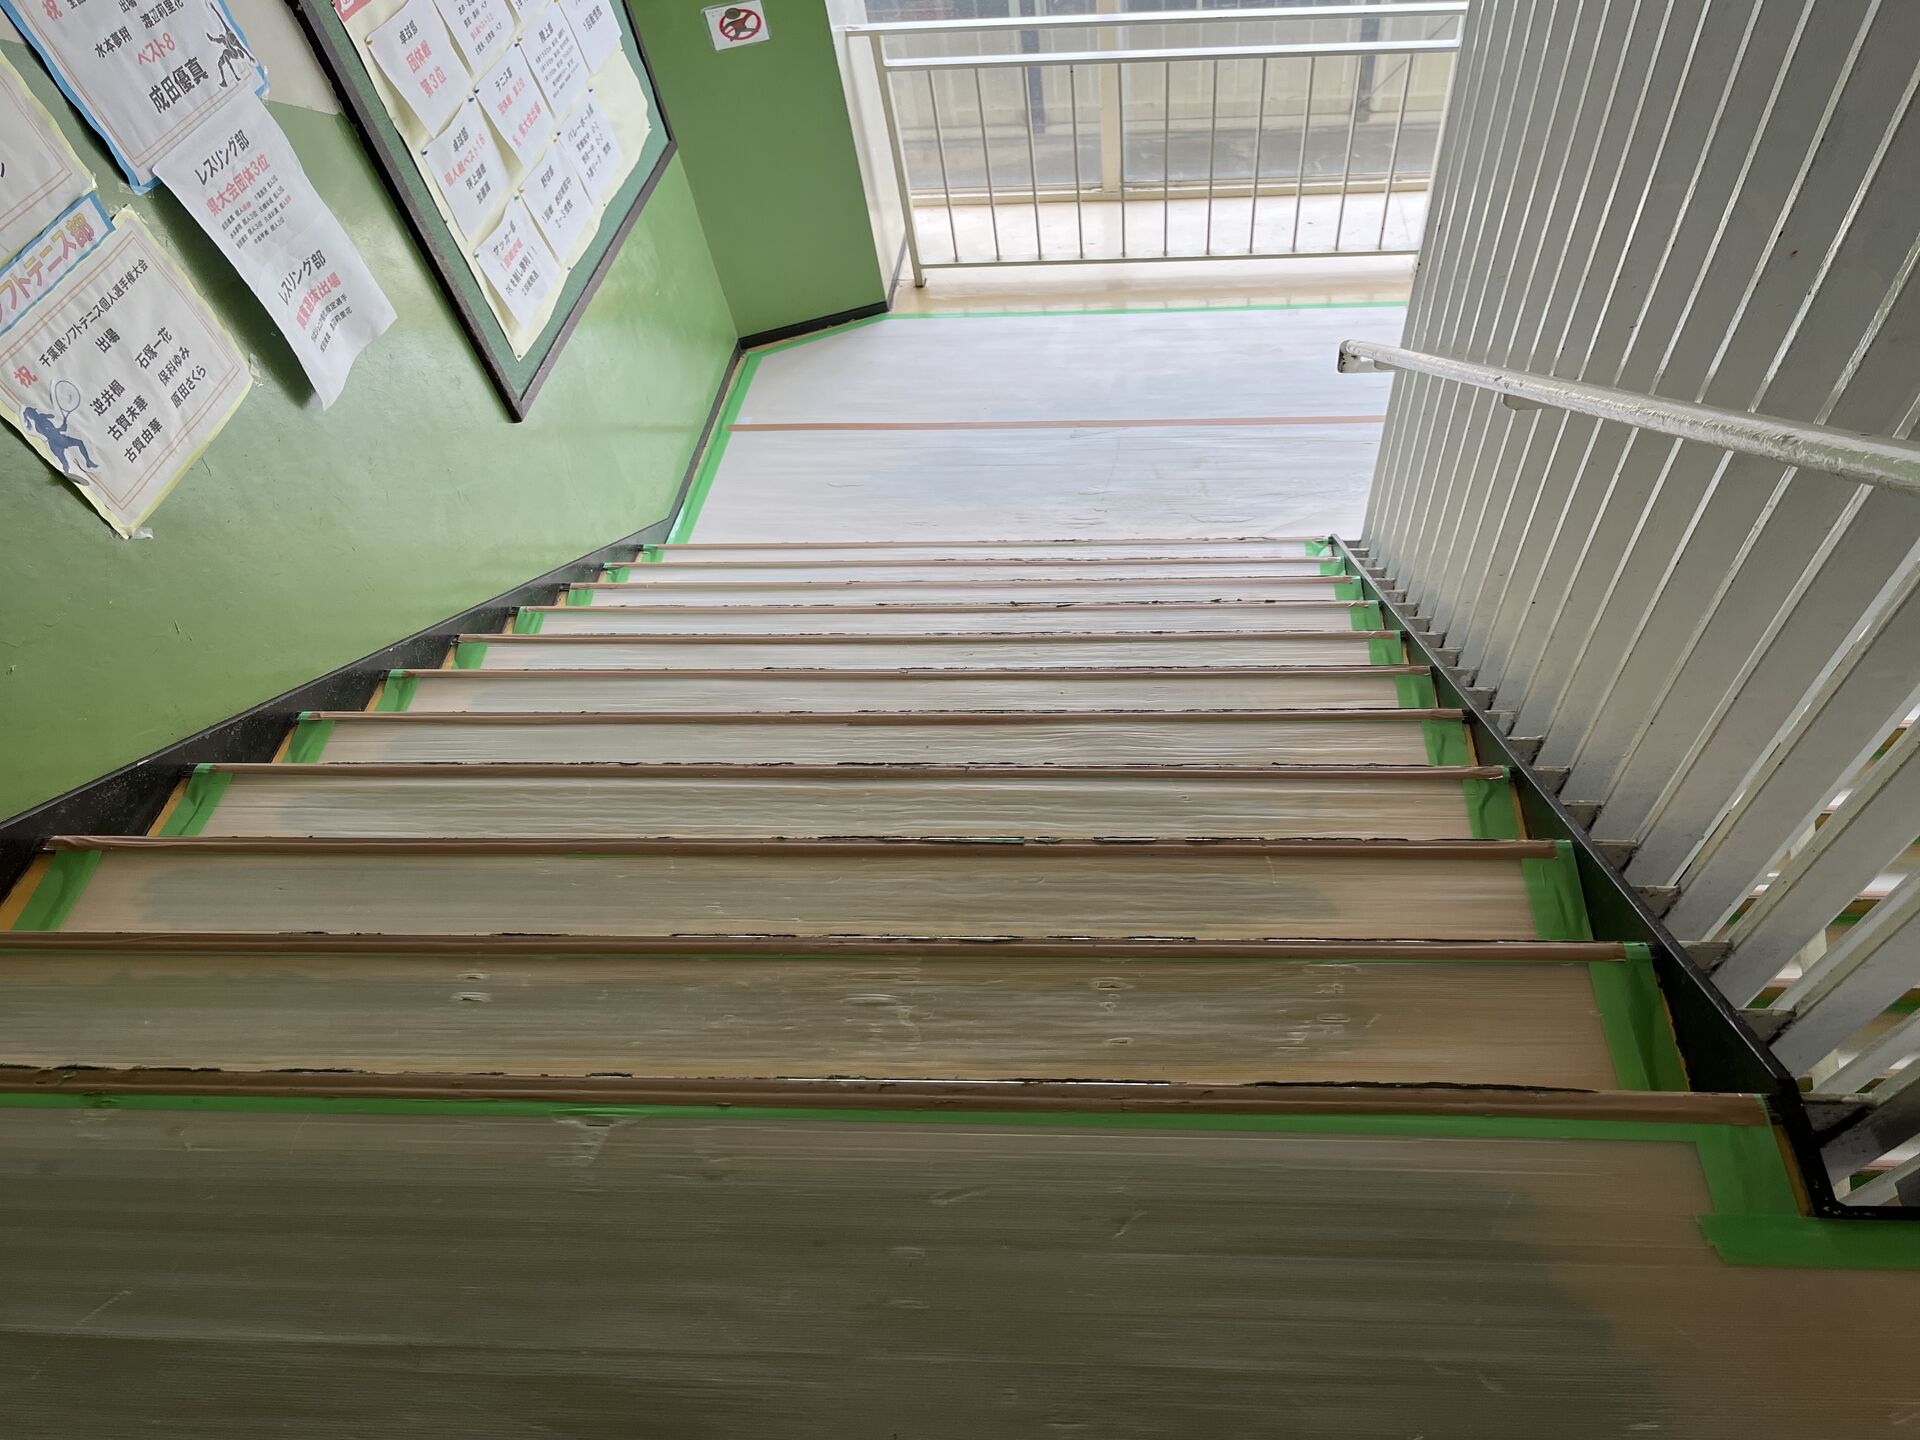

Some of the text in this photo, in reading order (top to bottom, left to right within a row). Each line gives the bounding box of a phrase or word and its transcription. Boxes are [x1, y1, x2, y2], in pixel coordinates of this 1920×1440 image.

[137, 32, 176, 65] ベスト8
[149, 56, 209, 114] 成田優真
[195, 128, 250, 185] レスリング部
[206, 152, 271, 217] 県大会団体3位
[0, 212, 95, 323] フトテニス部
[278, 249, 326, 306] レスリング部
[14, 258, 149, 390] 祝 千葉県ソフトテニス個人選手権大会
[94, 327, 121, 354] 出場
[89, 326, 173, 417] 逆井楓 石塚一花
[106, 345, 191, 442] 古賀未華 保科ゆみ
[123, 364, 207, 464] 古賀由華 原田さくら
